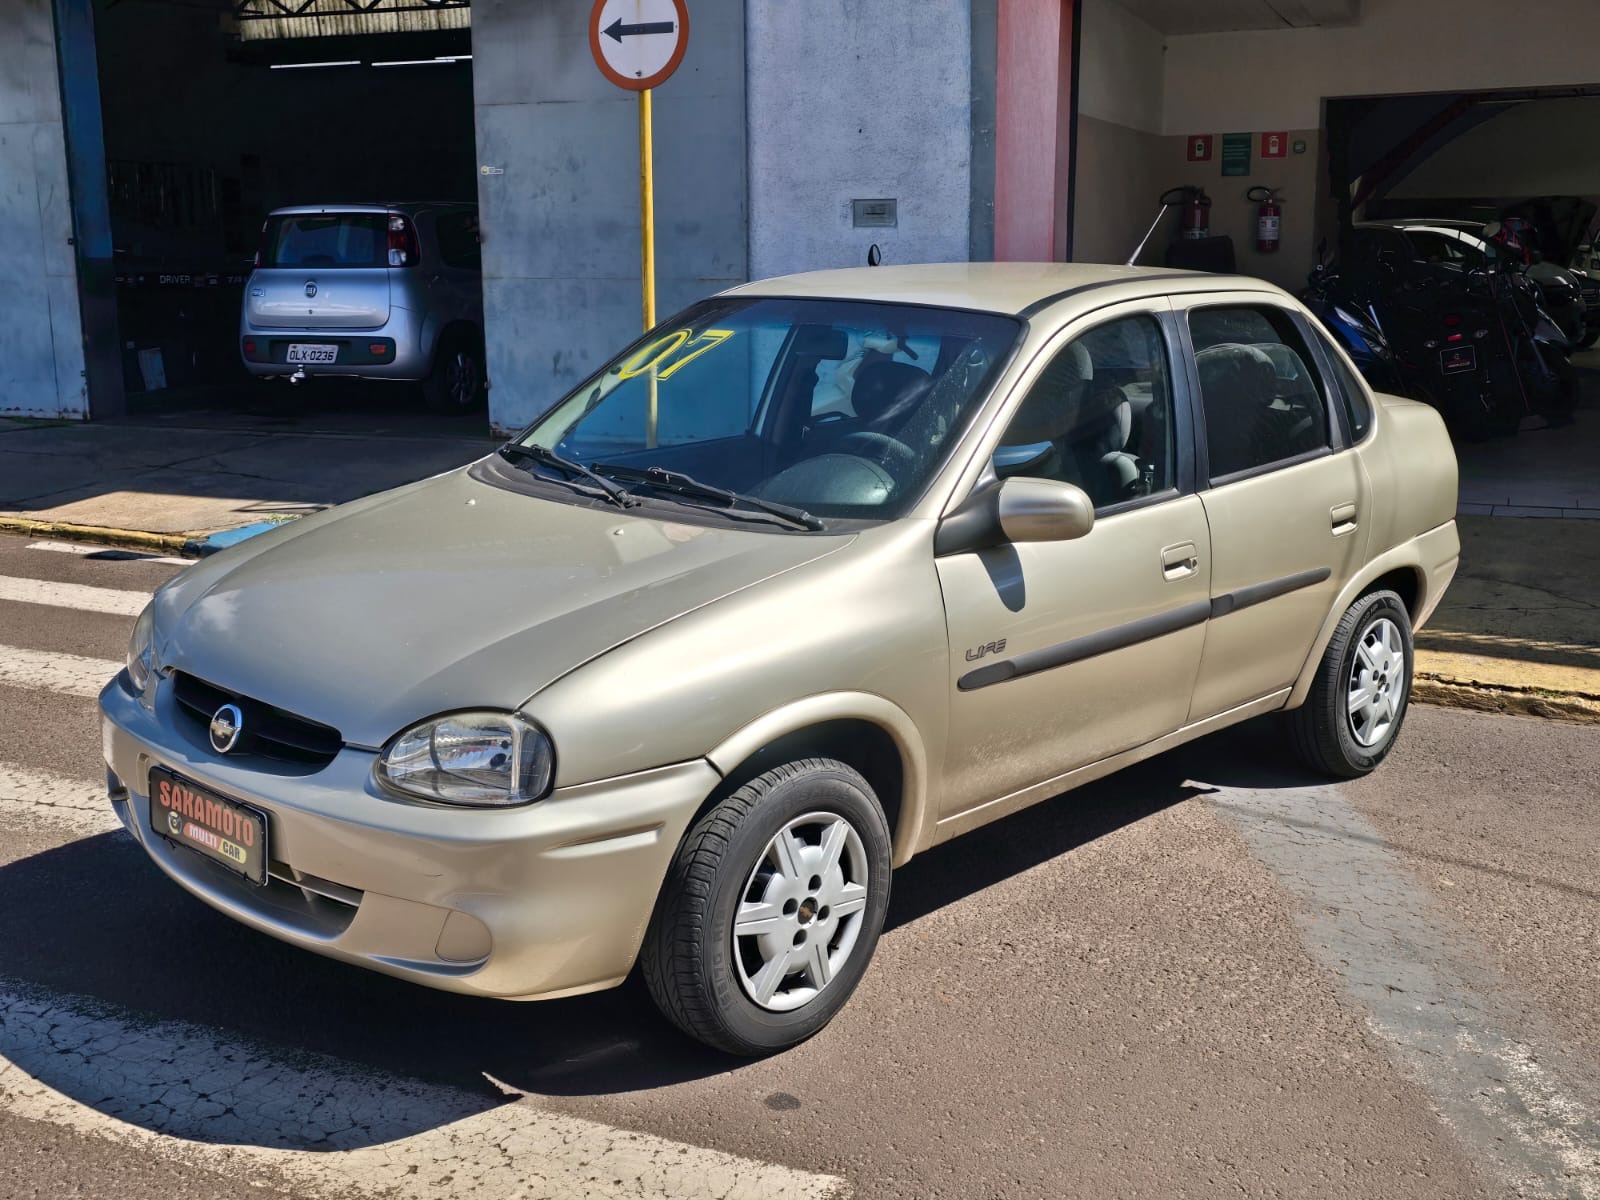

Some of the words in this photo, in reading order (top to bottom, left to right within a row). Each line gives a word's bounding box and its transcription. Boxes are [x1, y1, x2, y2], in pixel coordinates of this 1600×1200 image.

[965, 638, 1007, 662] LIFE
[159, 780, 254, 847] SAKAMOTO
[189, 824, 218, 848] MULTI
[222, 840, 241, 860] CAR
